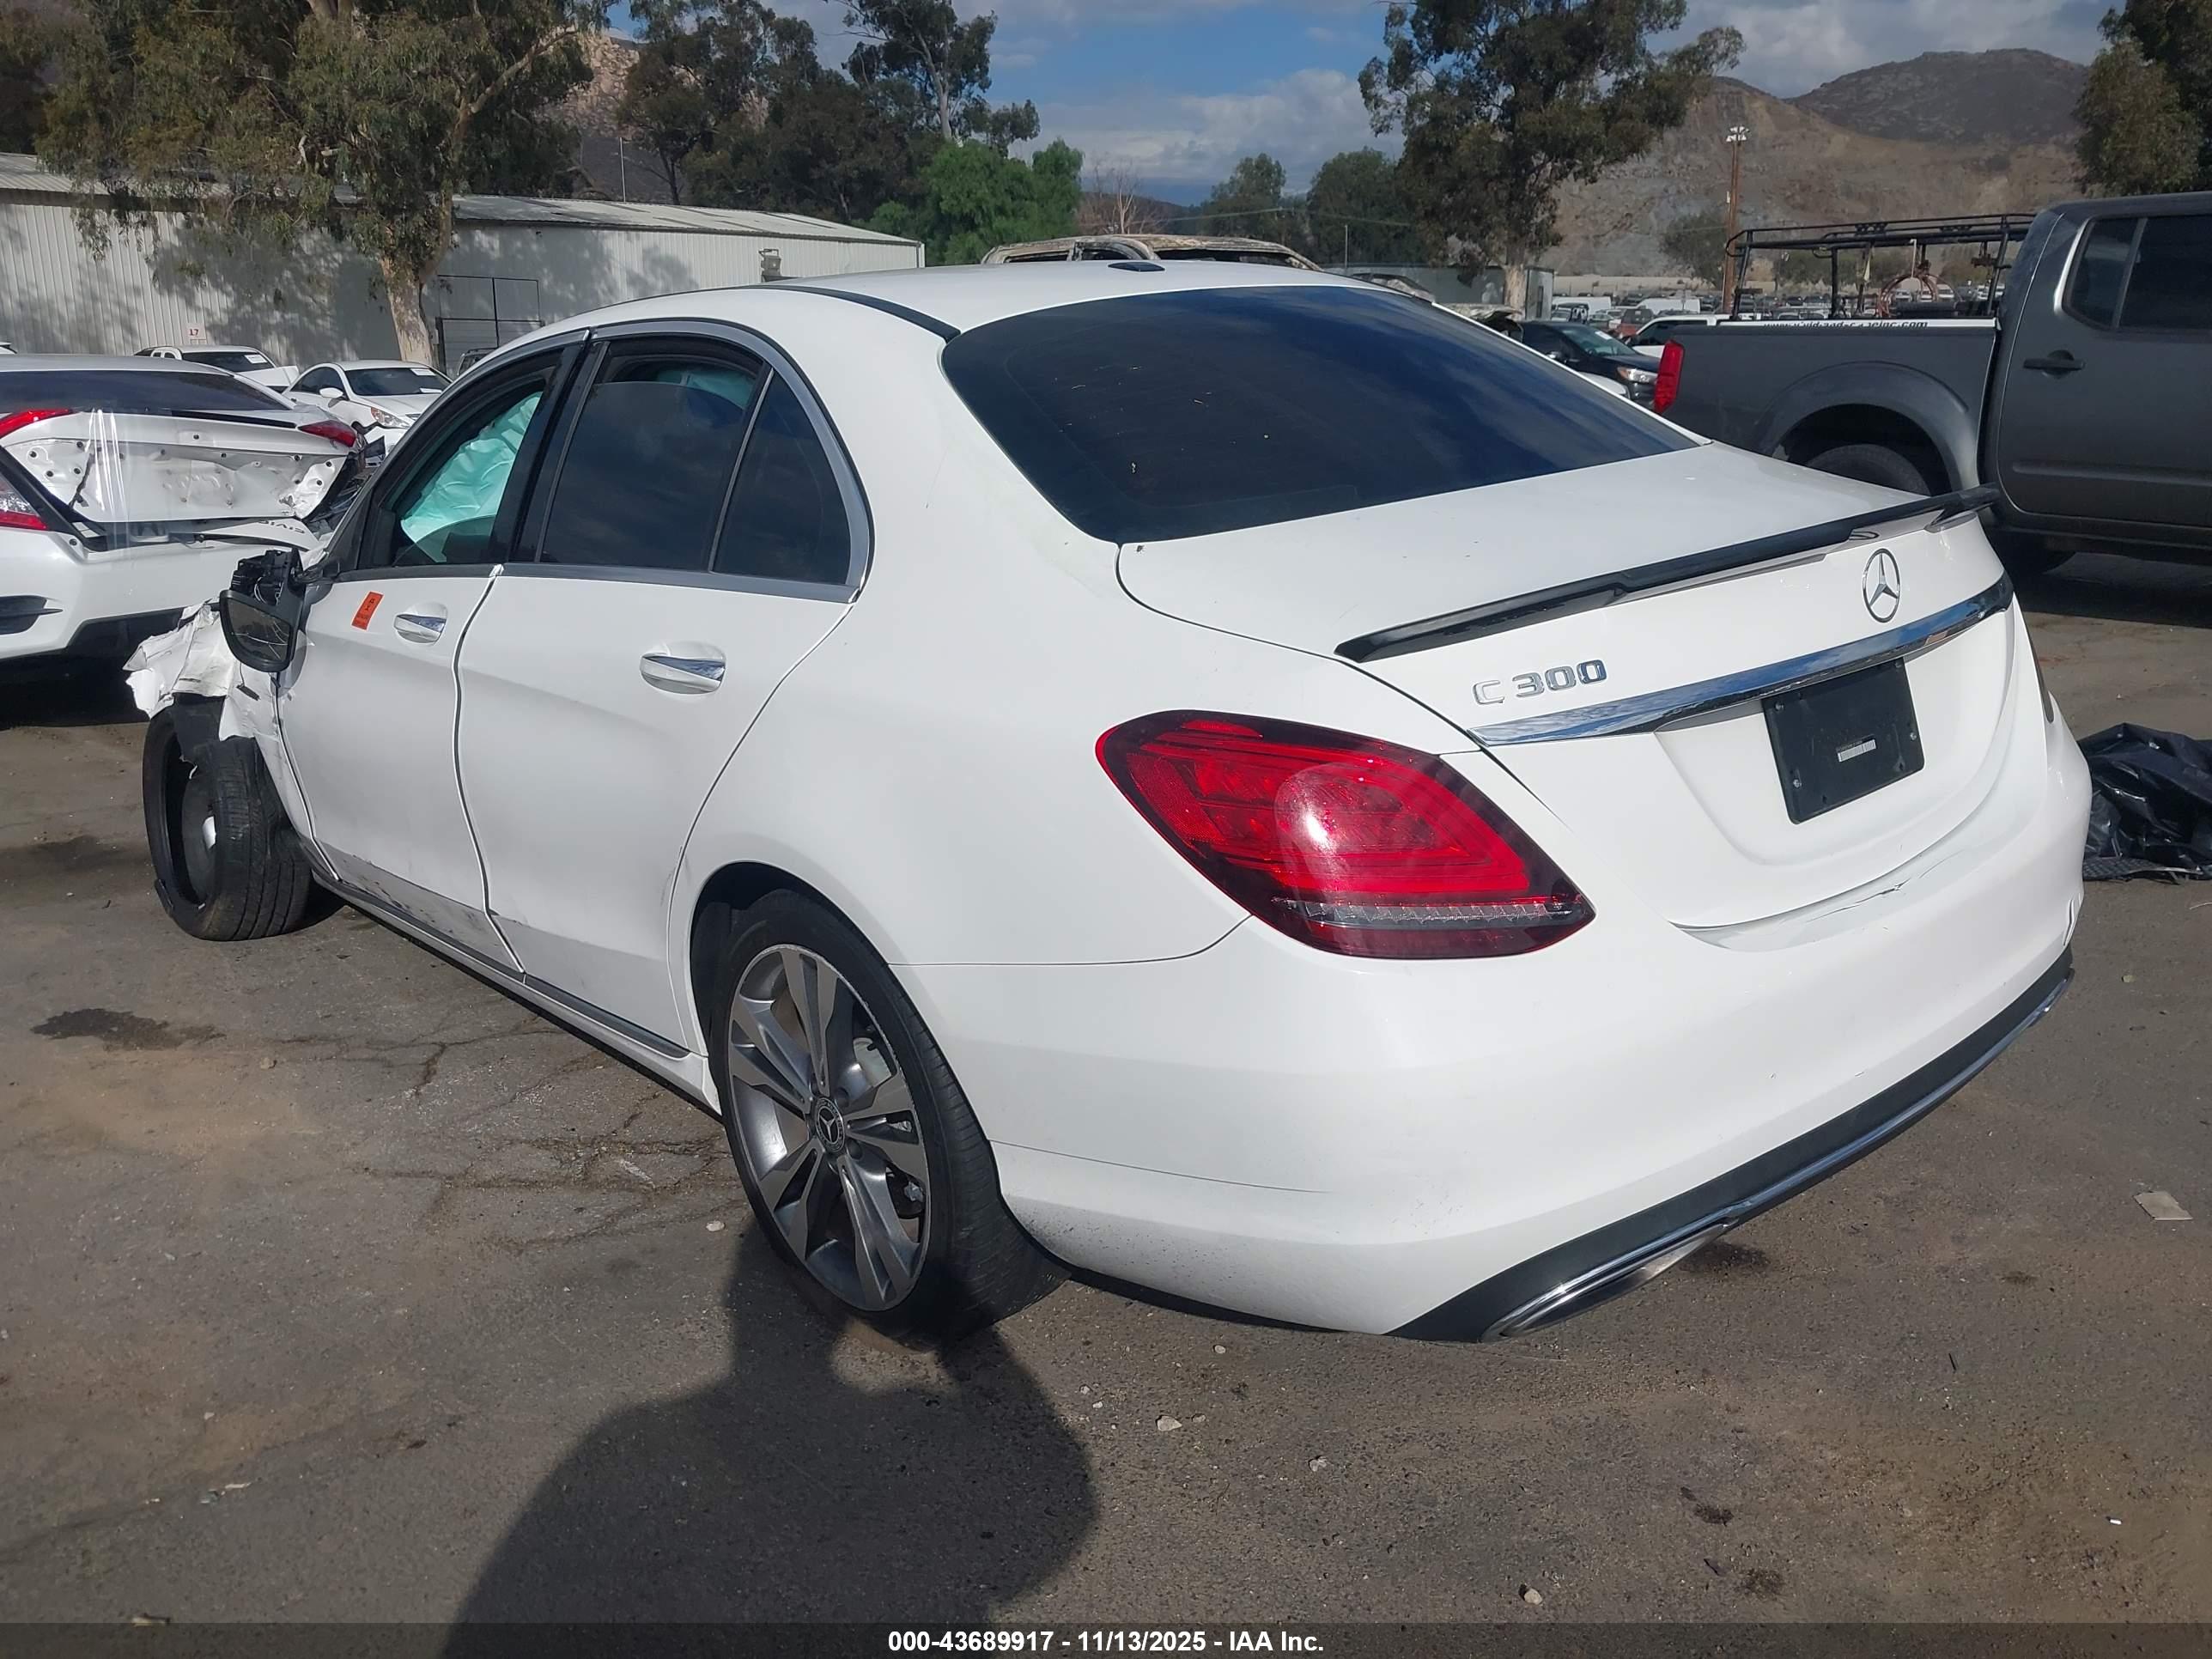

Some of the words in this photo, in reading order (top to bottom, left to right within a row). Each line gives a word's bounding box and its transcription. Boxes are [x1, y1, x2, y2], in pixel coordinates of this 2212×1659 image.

[258, 520, 306, 533] CIVIC
[1473, 679, 1505, 705] C
[1511, 659, 1608, 698] 300
